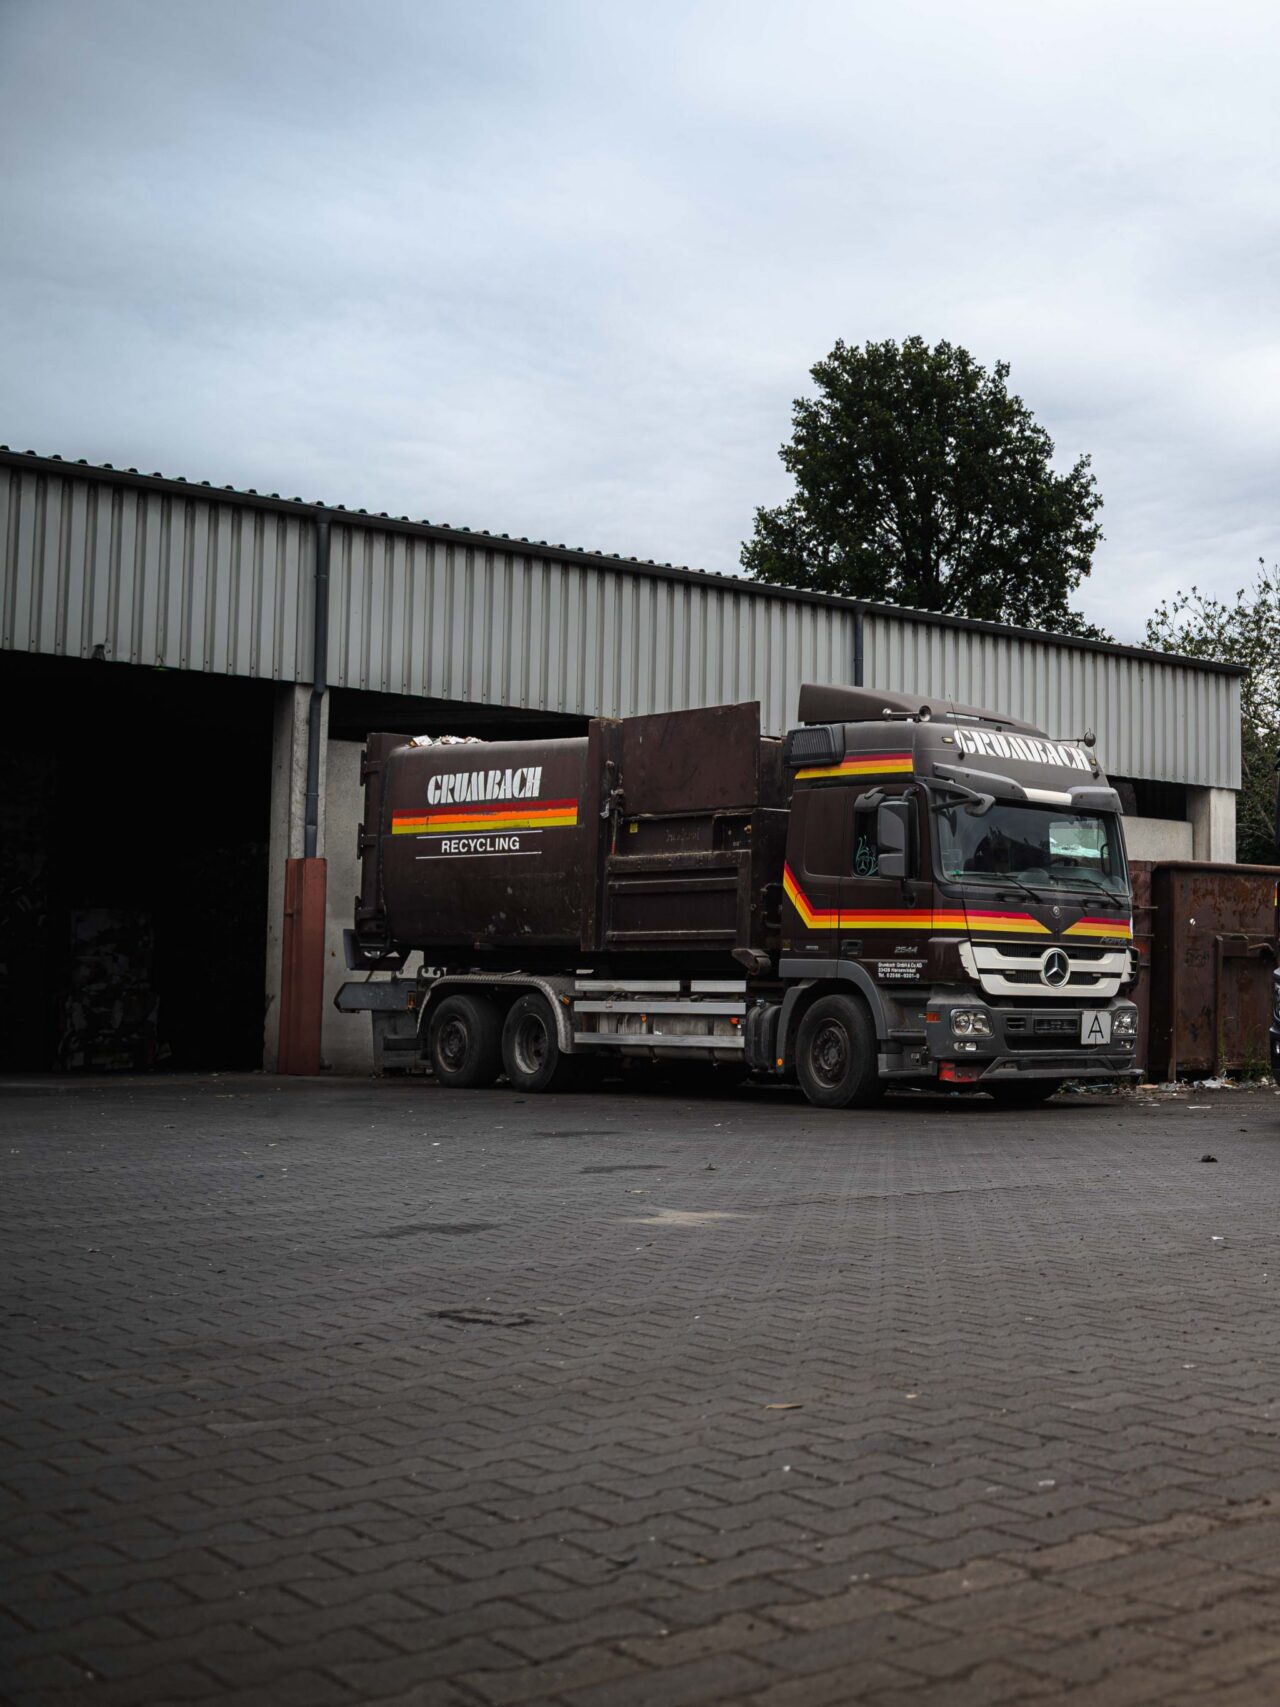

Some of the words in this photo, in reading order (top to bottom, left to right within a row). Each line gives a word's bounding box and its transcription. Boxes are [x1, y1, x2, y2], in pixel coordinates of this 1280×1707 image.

[954, 729, 1091, 771] GRUMBACH
[427, 767, 543, 805] GRUMBACH
[441, 836, 520, 853] RECYCLING
[1088, 1014, 1105, 1039] A
